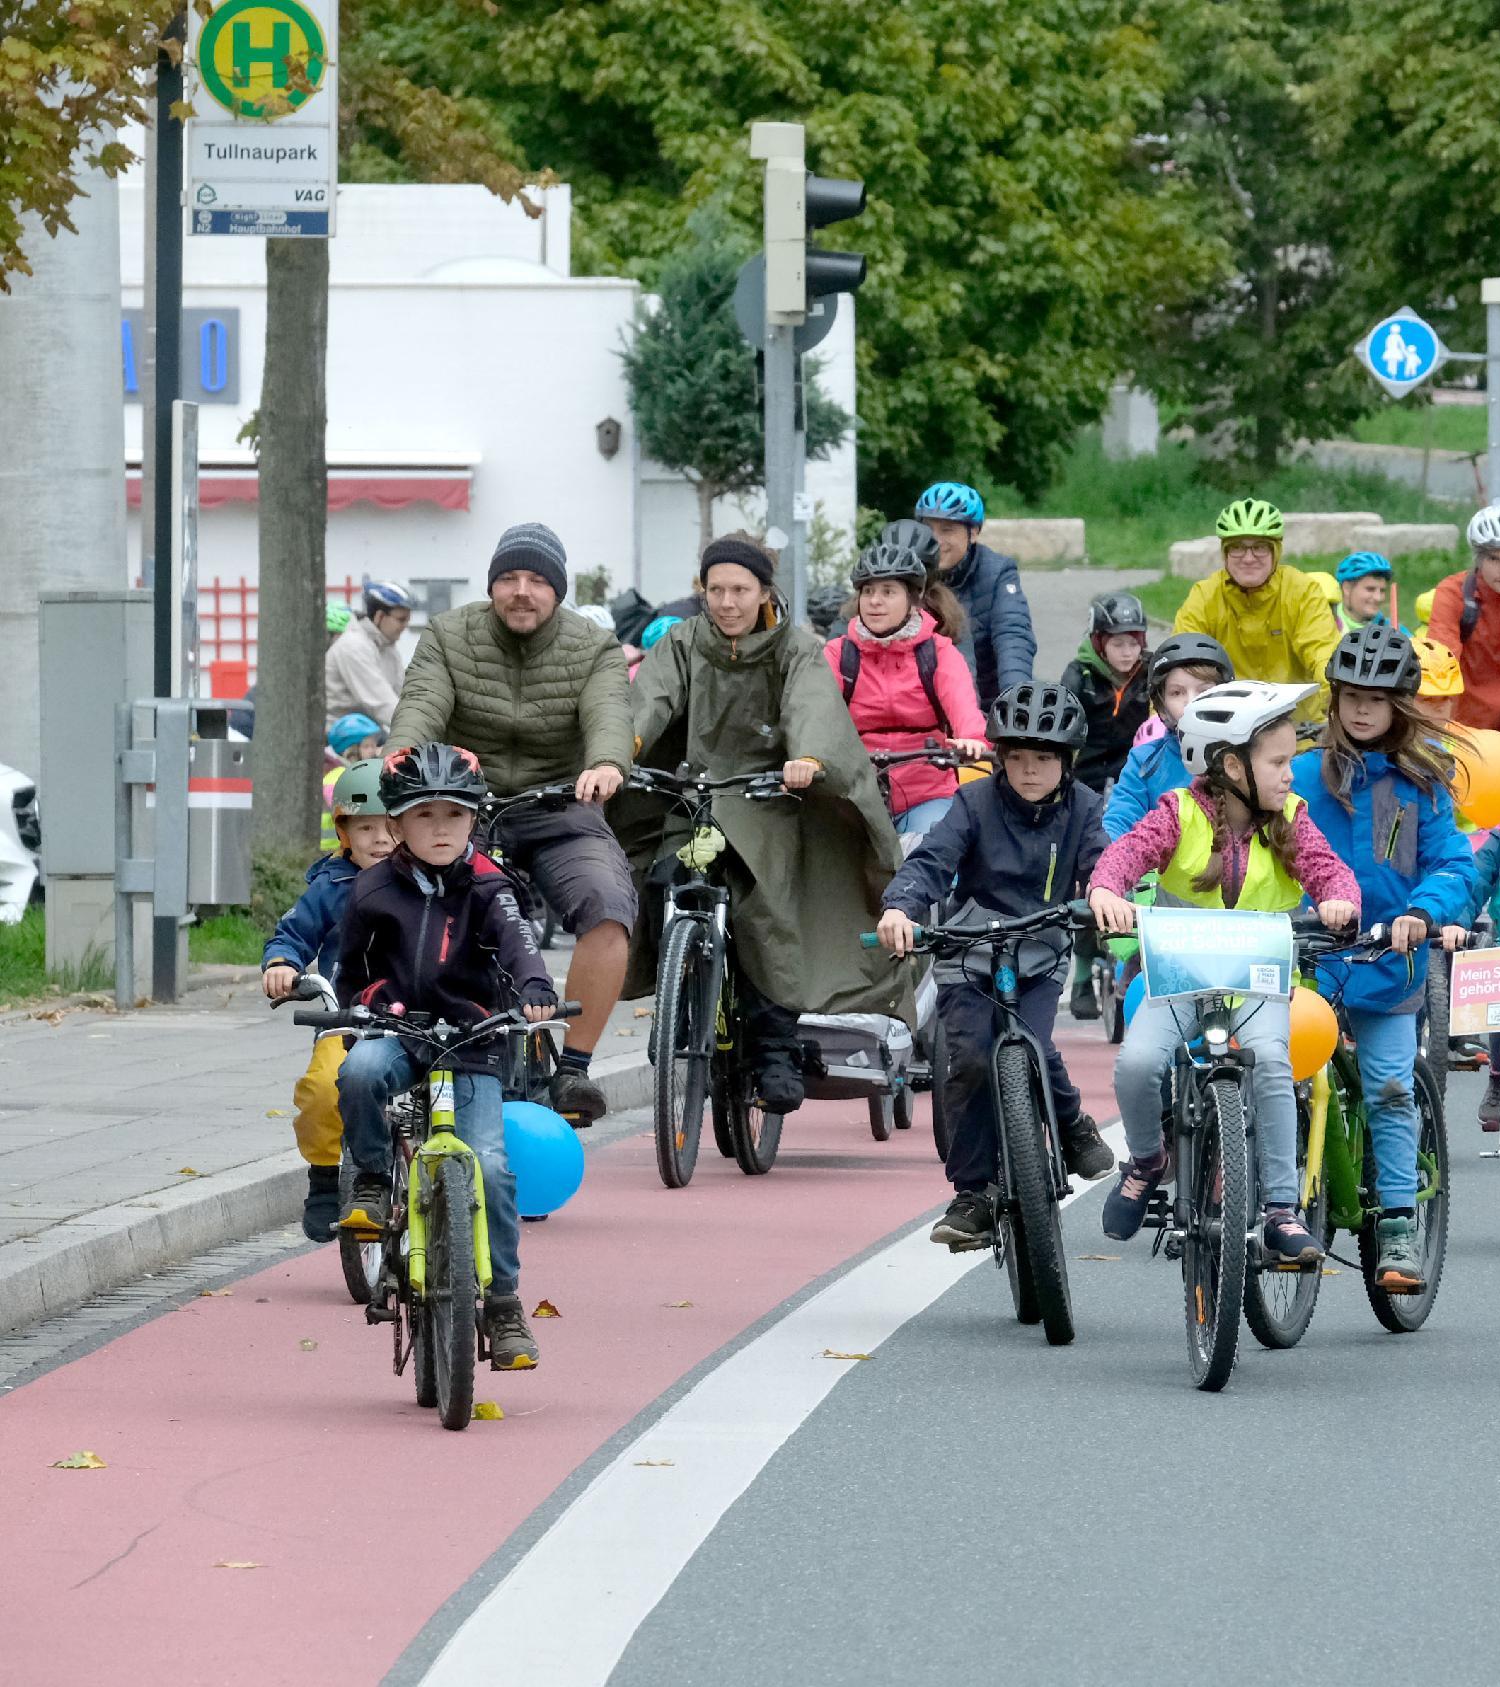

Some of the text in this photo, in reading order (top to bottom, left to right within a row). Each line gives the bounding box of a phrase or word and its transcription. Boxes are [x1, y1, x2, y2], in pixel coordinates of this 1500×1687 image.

[233, 22, 290, 88] H
[204, 143, 317, 163] Tullnaupark
[295, 190, 325, 201] VAG
[229, 224, 301, 235] Hauptbahnhof
[1192, 933, 1259, 949] Schule
[1460, 967, 1491, 981] Mein
